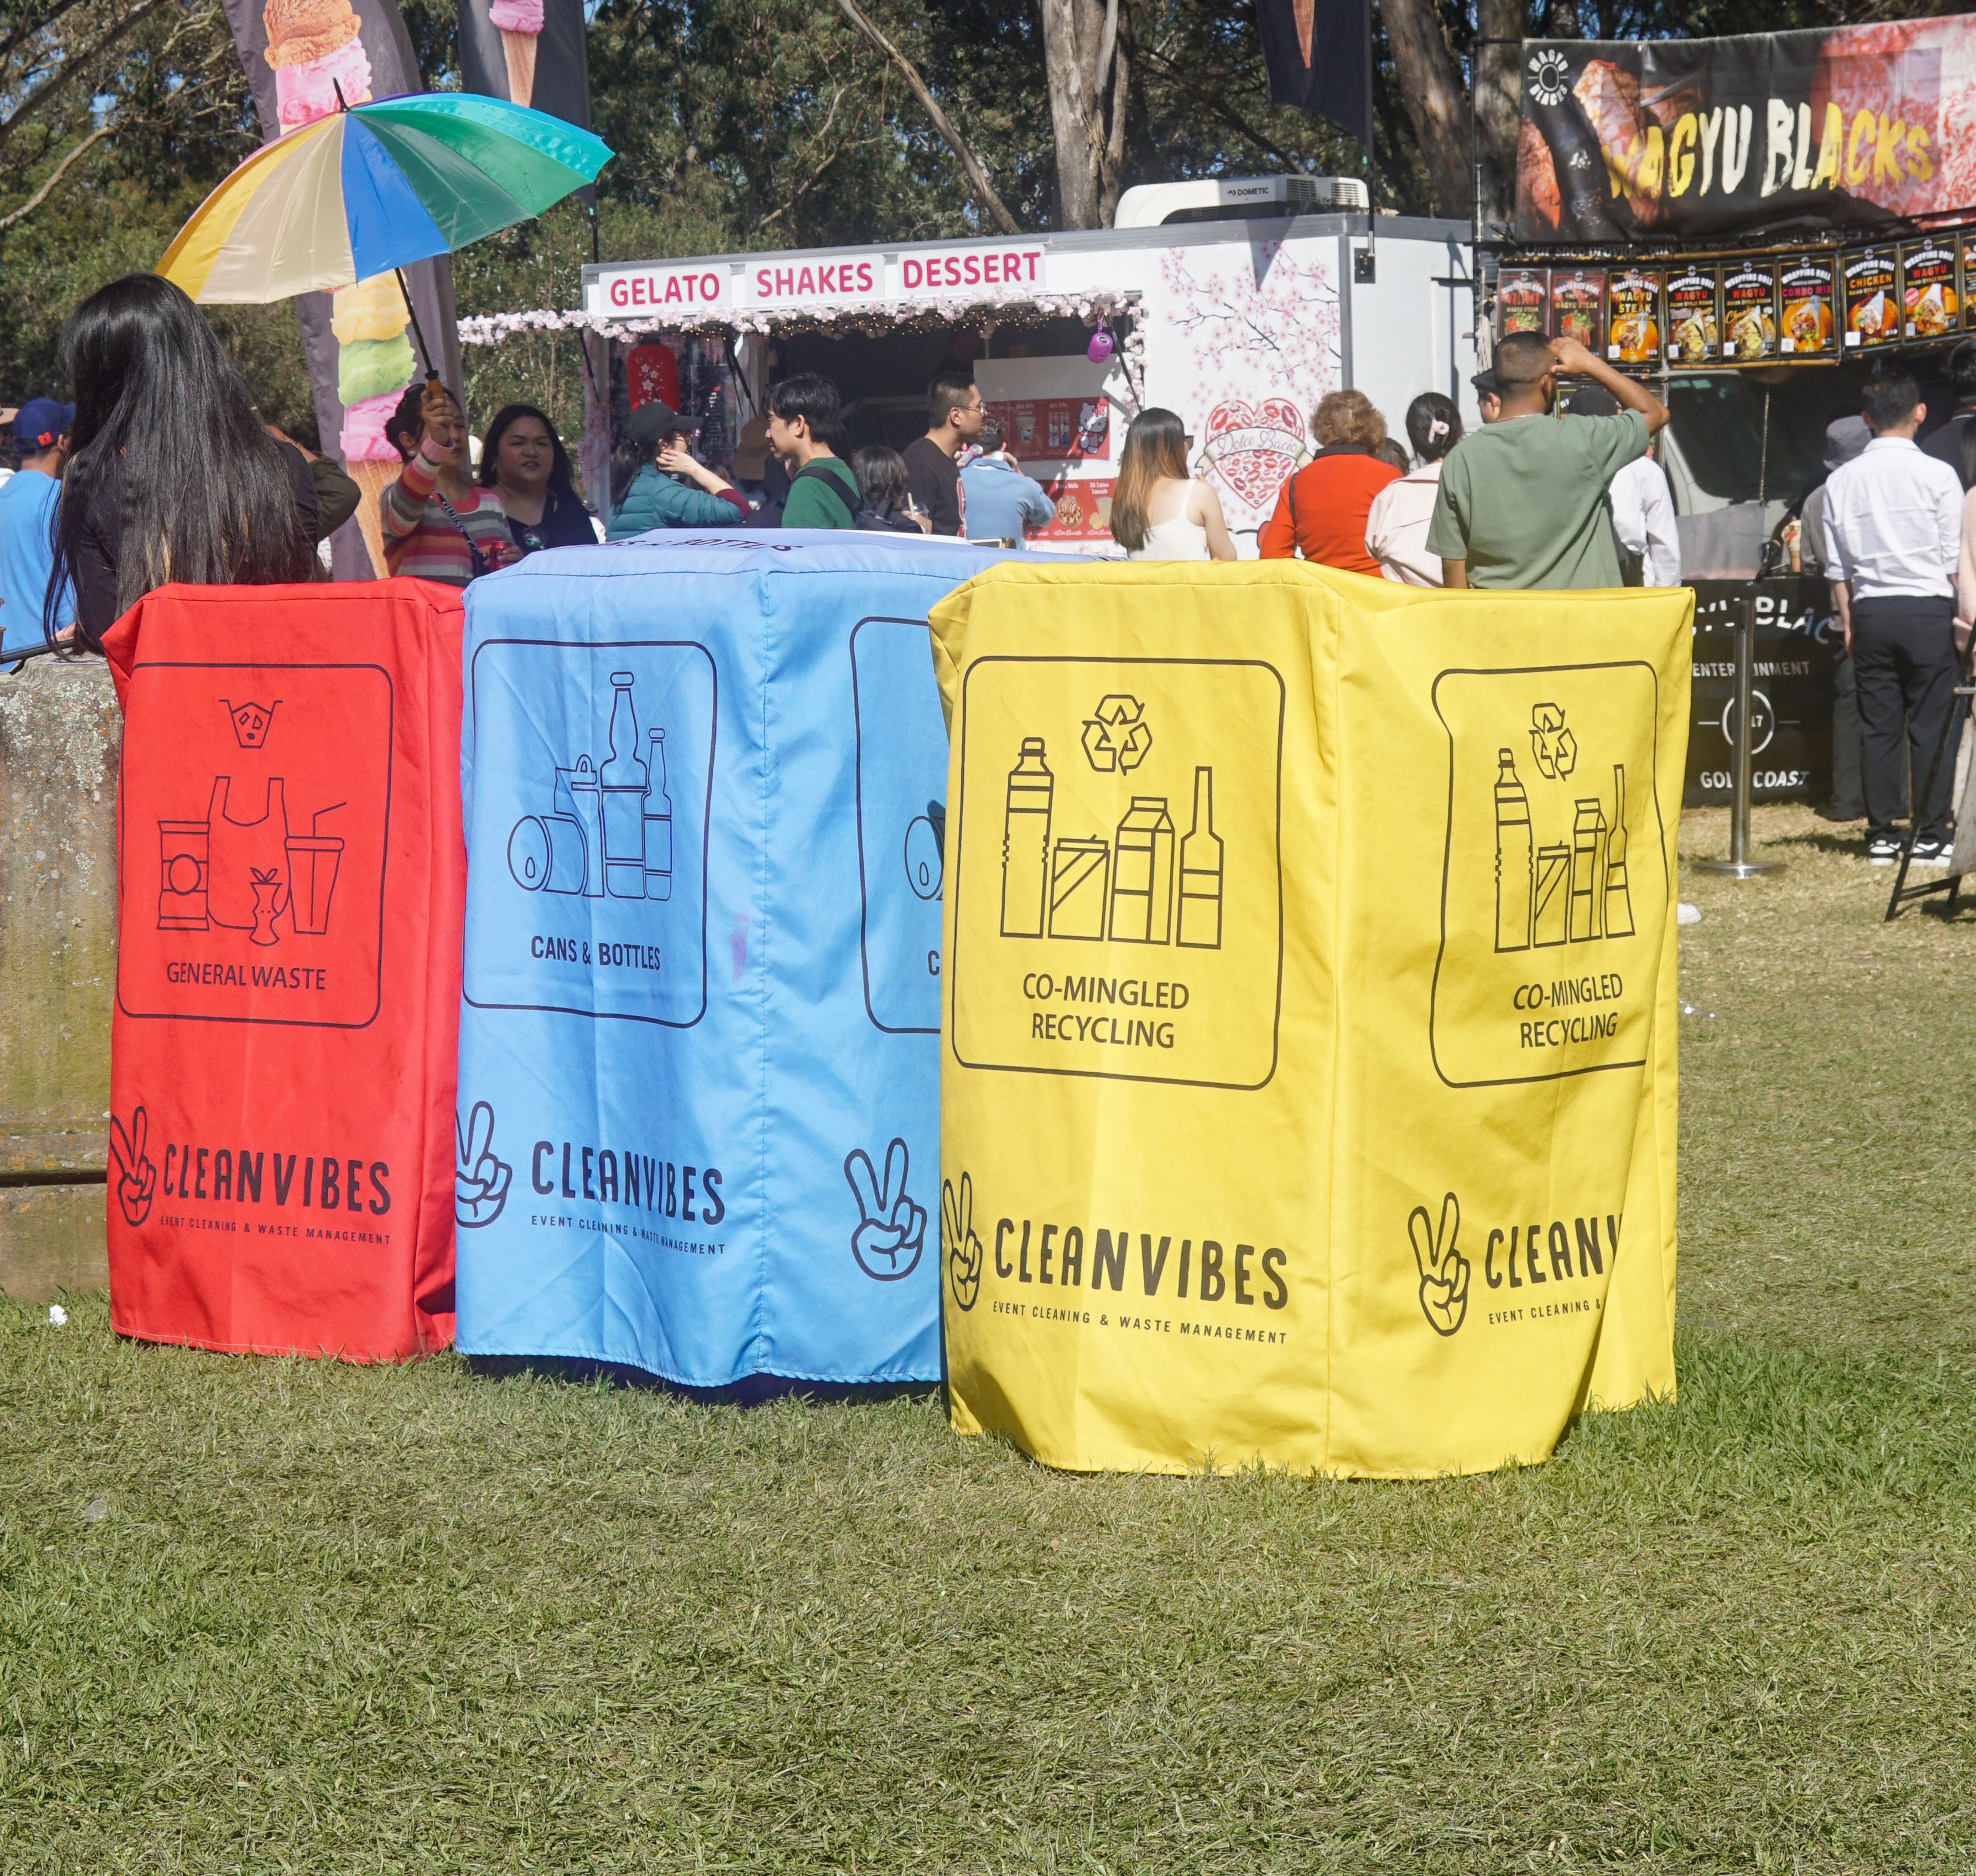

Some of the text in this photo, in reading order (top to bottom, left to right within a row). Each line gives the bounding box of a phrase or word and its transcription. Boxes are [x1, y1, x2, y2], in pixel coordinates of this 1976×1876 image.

[1528, 49, 1568, 72] WAGYU
[1529, 84, 1567, 105] BLACKS
[1602, 99, 1934, 198] WAGYU BLACKS
[1238, 187, 1268, 196] DOMETIC
[757, 262, 873, 298] SHAKES
[903, 252, 1042, 289] DESSERT
[1849, 274, 1892, 289] CHICKEN
[1912, 264, 1947, 278] WAGYU
[610, 273, 720, 307] GELATO
[1619, 291, 1652, 302] WAGYU
[1675, 290, 1708, 300] WAGYU
[1733, 288, 1766, 298] WAGYU
[1782, 285, 1831, 297] COMBO MIX
[1618, 304, 1651, 313] STEAK
[1218, 429, 1297, 455] Dolce Bacio
[1700, 770, 1810, 788] GOL COAST
[531, 935, 660, 971] CANS & BOTTLES
[167, 962, 326, 990] GENERAL WASTE
[1023, 973, 1190, 1009] CO-MINGLED
[1513, 973, 1623, 1010] CO-MINGLED
[1032, 1013, 1175, 1049] RECYCLING
[1520, 1012, 1618, 1048] RECYCLING
[163, 1143, 391, 1215] CLEANVIBES
[532, 1140, 726, 1226] CLEANVIBES
[161, 1216, 392, 1245] EVENT CLEANING & WASTE MANAGEMENT
[531, 1215, 725, 1254] EVENT CLEANING & WASTE MANAGEMENT
[995, 1217, 1288, 1310] CLEANVIBES
[993, 1301, 1287, 1344] EVENT CLEANING & WASTE MANAGEMENT
[1489, 1298, 1601, 1325] EVENT CLEANING &
